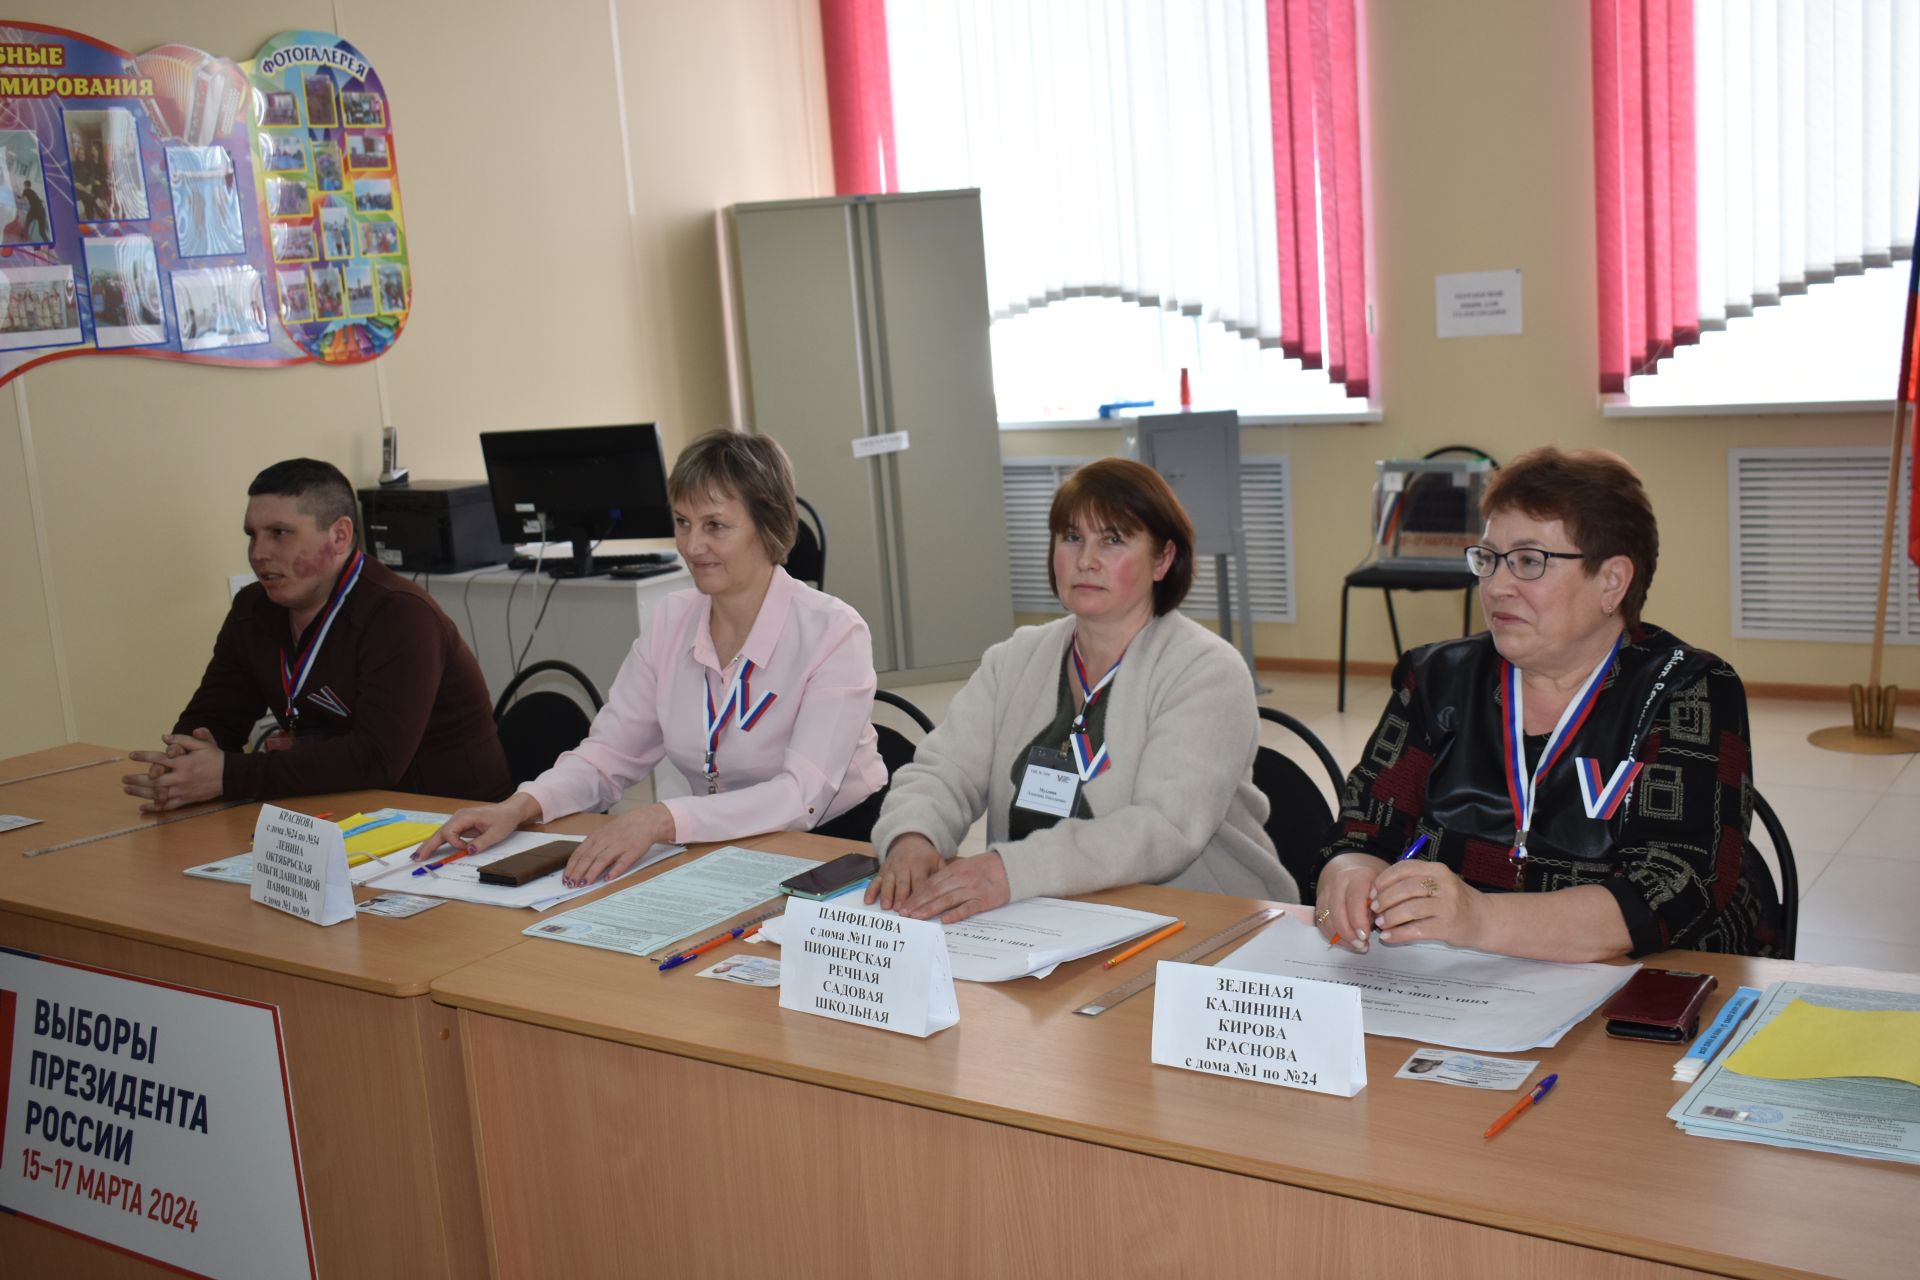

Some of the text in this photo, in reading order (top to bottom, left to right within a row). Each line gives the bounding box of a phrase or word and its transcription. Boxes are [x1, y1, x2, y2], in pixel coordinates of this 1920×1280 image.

[262, 47, 366, 77] ФОТОГАЛЕРЕЯ
[0, 77, 154, 96] МИРОВАНИЯ
[279, 810, 314, 829] КРАСНОВА
[270, 825, 285, 836] дома
[286, 828, 298, 840] №24
[298, 833, 306, 842] по
[306, 835, 320, 846] №34
[276, 840, 304, 856] ЛЕНИНА
[265, 851, 313, 875] ОКТЯБРЬСКАЯ
[257, 863, 320, 892] ОЛЬГИ ДАНИЛОВОЙ
[266, 880, 308, 903] ПАНФИЛОВА
[267, 897, 281, 907] дома
[281, 897, 291, 908] №1
[292, 904, 300, 913] по
[300, 906, 310, 917] №9
[819, 907, 901, 934] ПАНФИЛОВА
[810, 926, 905, 953] с дома №11 по 17
[804, 940, 892, 969] ПИОНЕРСКАЯ
[828, 963, 880, 985] РЕЧНАЯ
[823, 980, 883, 1004] САДОВАЯ
[1216, 977, 1294, 1000] ЗЕЛЕНАЯ
[815, 996, 889, 1024] ШКОЛЬНАЯ
[1206, 996, 1303, 1022] КАЛИНИНА
[34, 998, 158, 1064] ВЫБОРЫ
[1218, 1018, 1287, 1040] КИРОВА
[1206, 1037, 1298, 1062] КРАСНОВА
[1185, 1056, 1318, 1086] с дома №1 по №24
[29, 1049, 208, 1134] ПРЕЗИДЕНТА
[25, 1099, 134, 1166] РОССИИ
[76, 1165, 142, 1216] МАРТА
[147, 1187, 199, 1233] 2024
